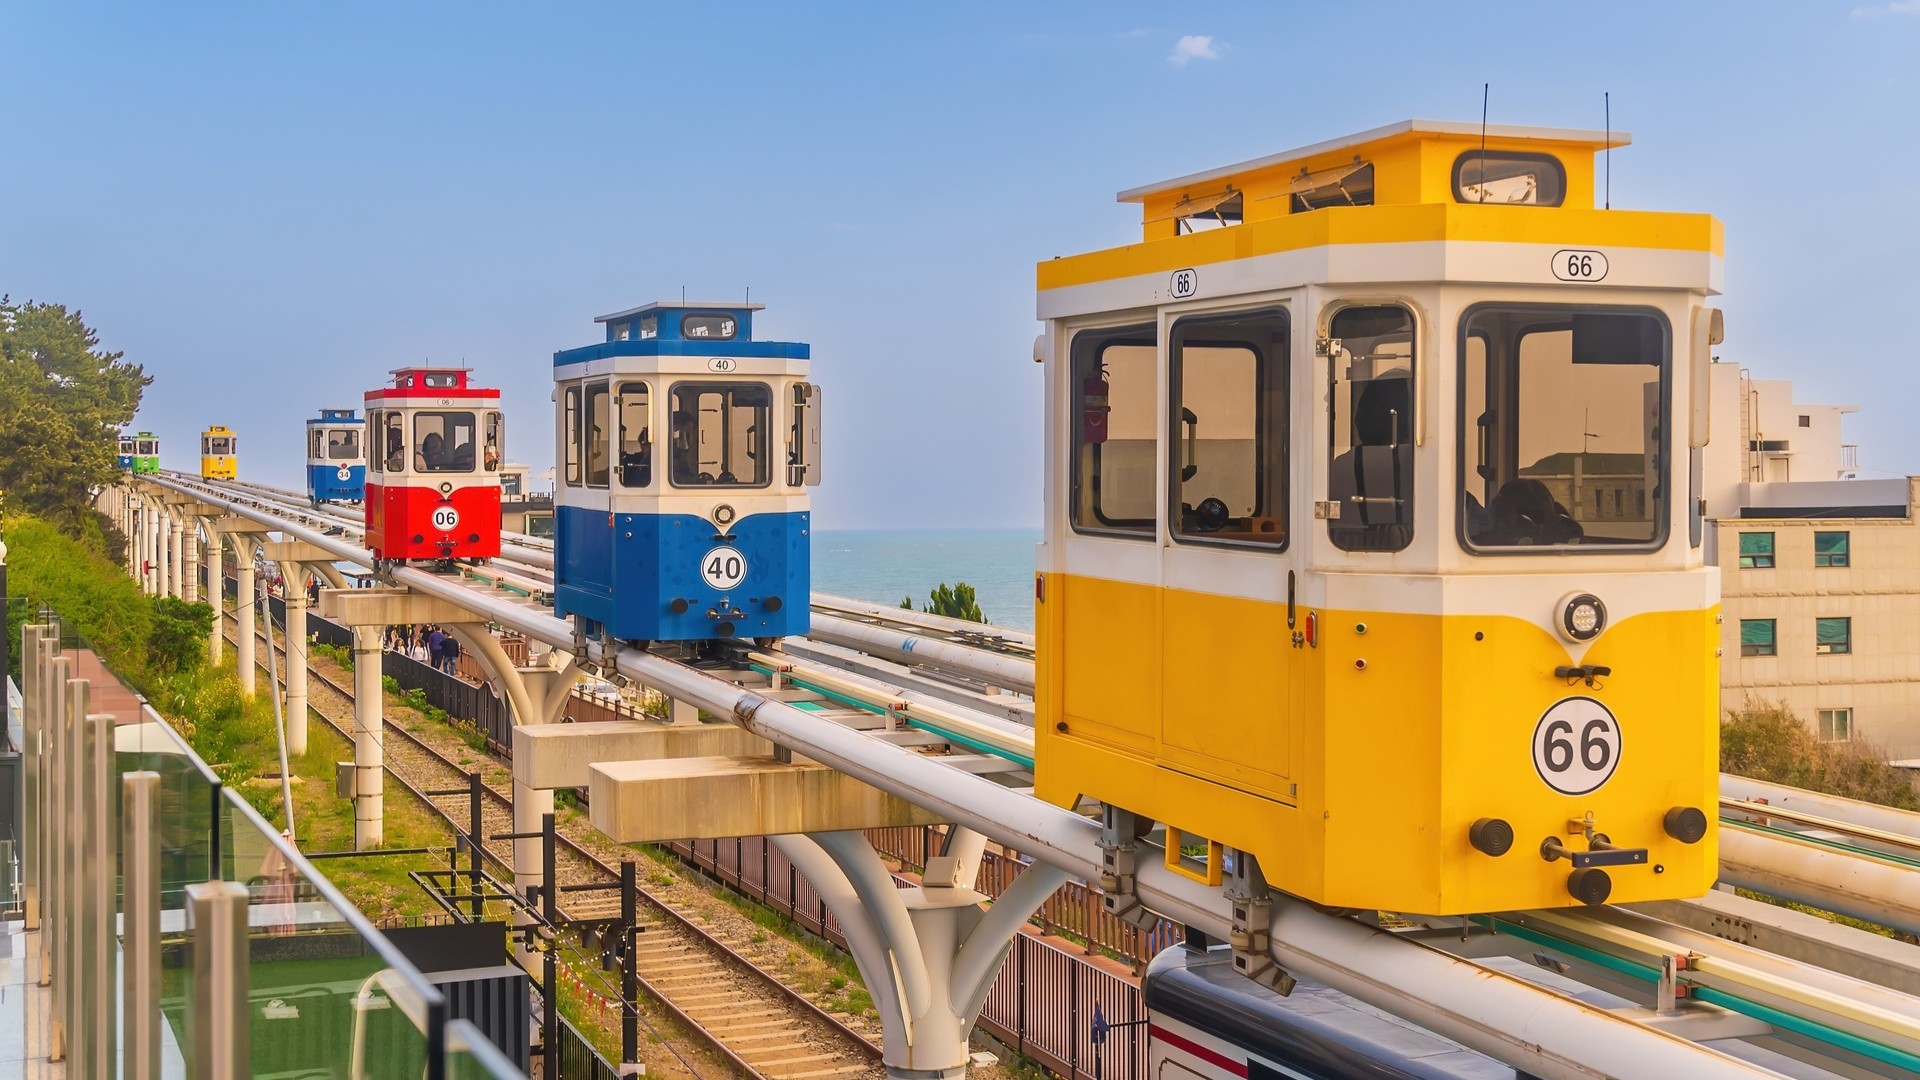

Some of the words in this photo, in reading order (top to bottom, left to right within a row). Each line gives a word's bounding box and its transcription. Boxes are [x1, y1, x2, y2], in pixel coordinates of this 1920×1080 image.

[1568, 254, 1592, 277] 66
[1178, 273, 1189, 293] 66
[715, 360, 728, 370] 40
[435, 511, 456, 526] 06
[707, 556, 741, 580] 40
[1543, 718, 1611, 773] 66
